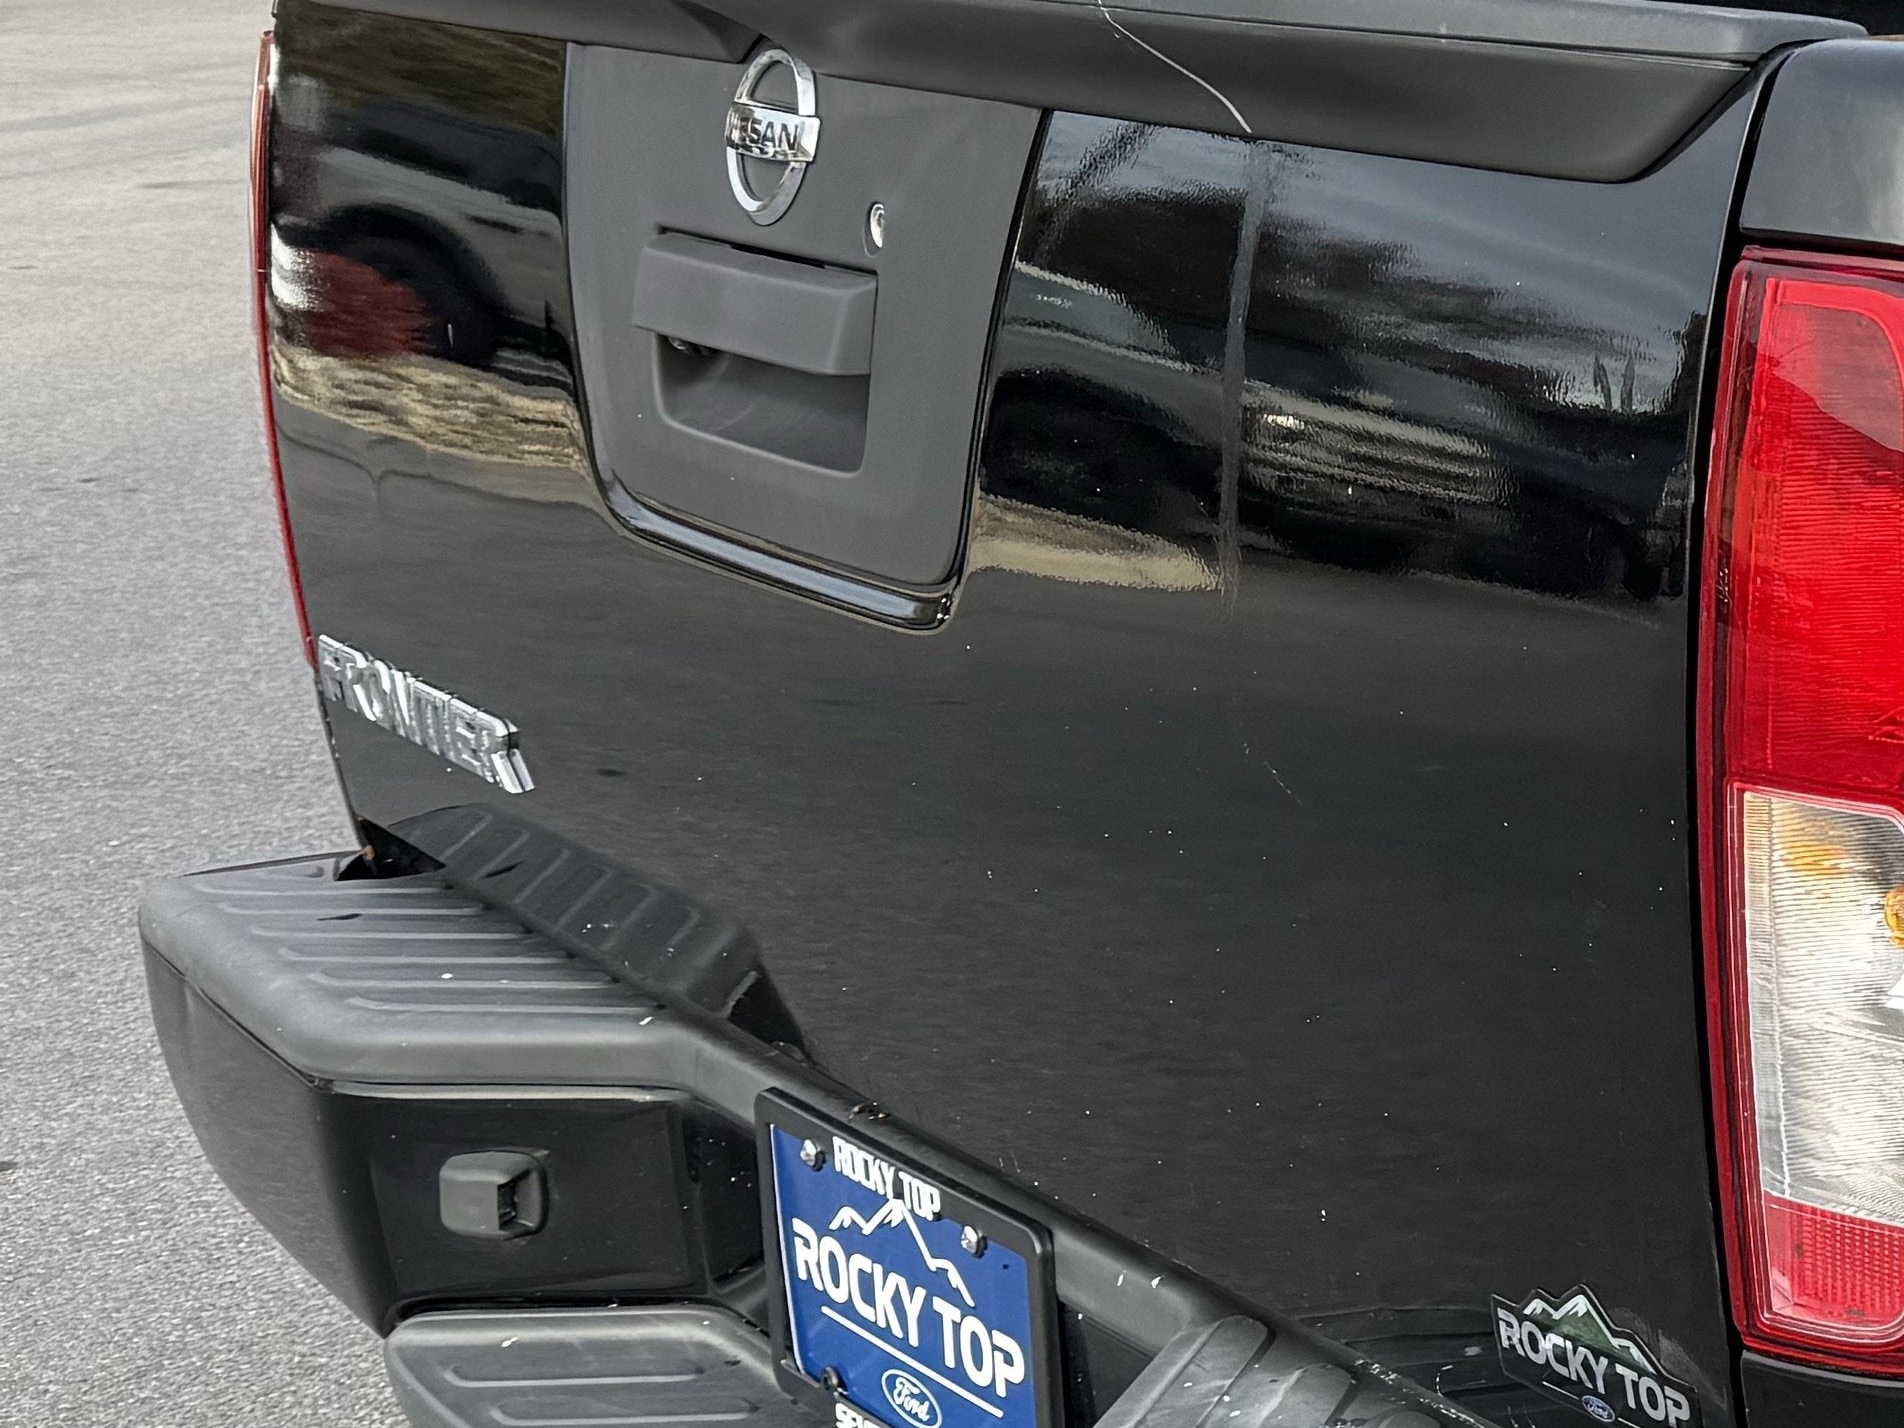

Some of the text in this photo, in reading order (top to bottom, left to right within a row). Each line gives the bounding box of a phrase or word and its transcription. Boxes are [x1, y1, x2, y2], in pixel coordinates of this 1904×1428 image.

[832, 1135, 941, 1221] ROCKY TOP
[793, 1218, 1025, 1398] ROCKY TOP
[892, 1376, 930, 1422] Ford
[1498, 1307, 1691, 1428] ROCKY TOP
